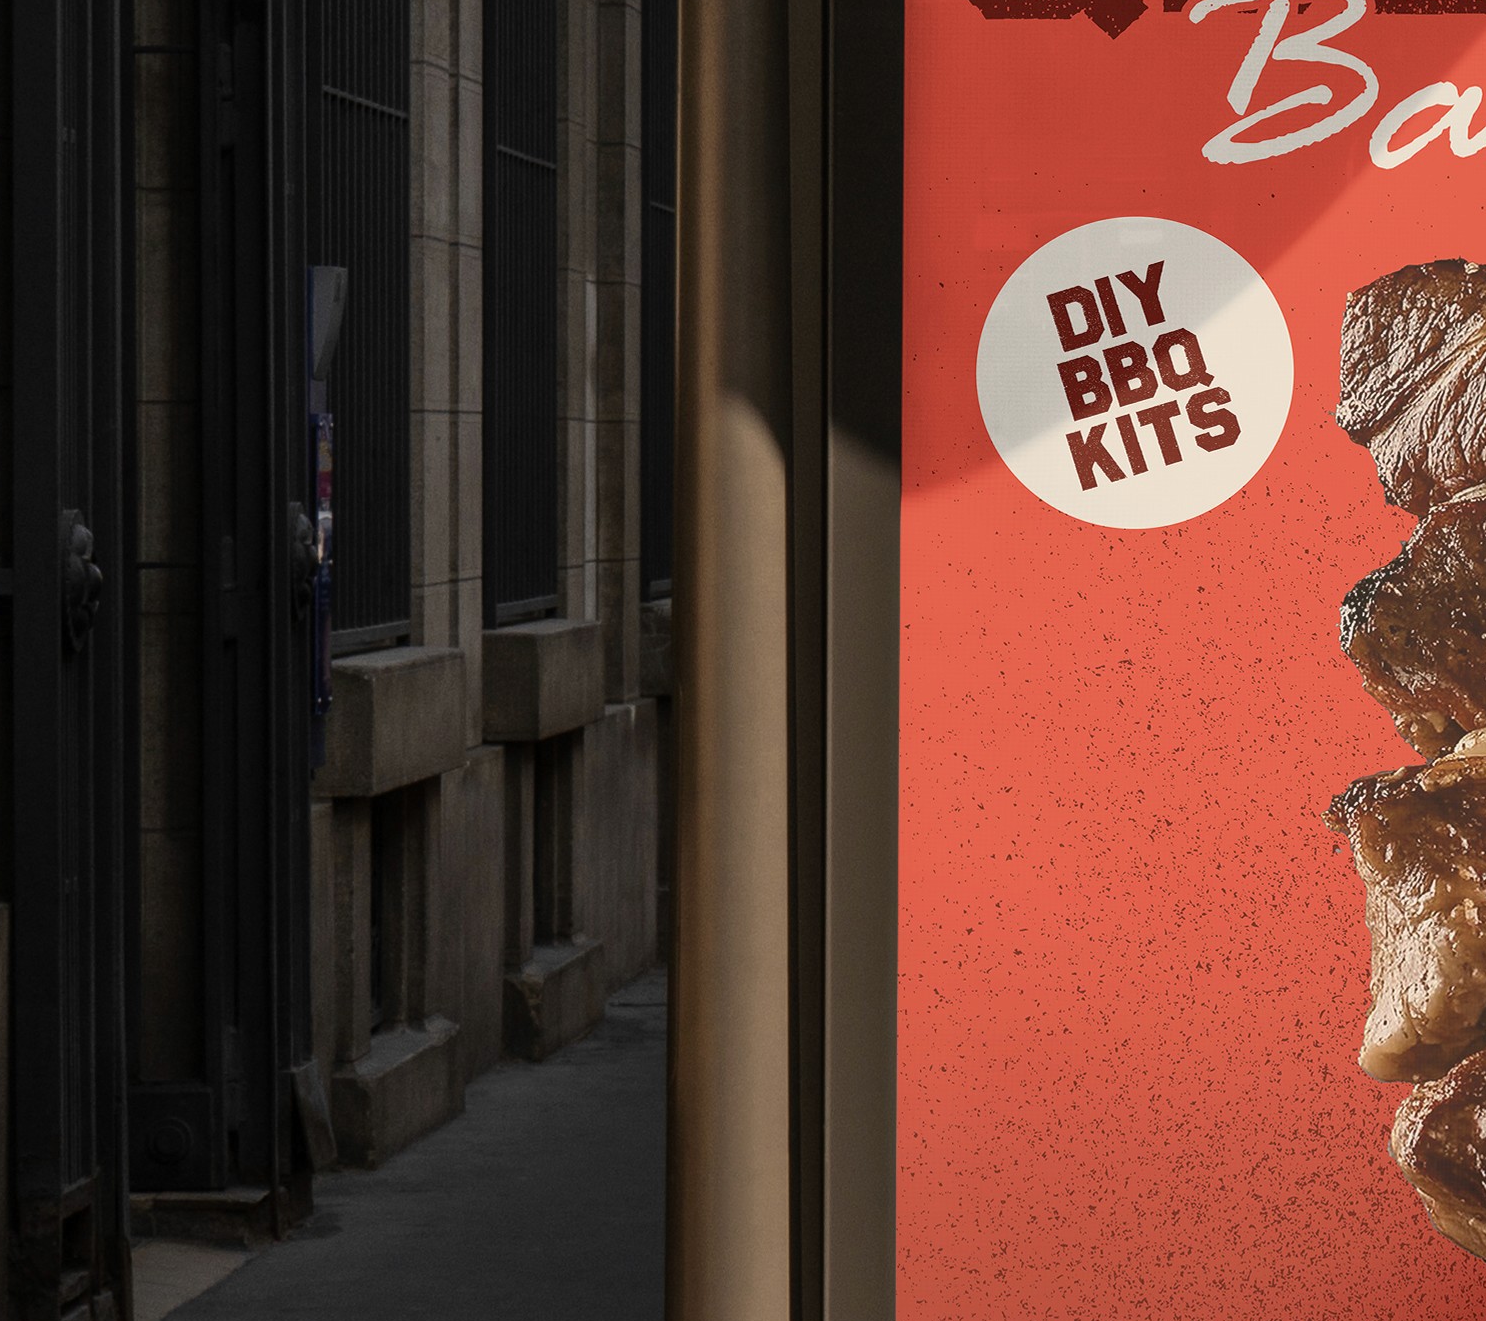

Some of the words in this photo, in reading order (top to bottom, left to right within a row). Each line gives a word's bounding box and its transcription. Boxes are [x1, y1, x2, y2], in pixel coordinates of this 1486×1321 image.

[1046, 260, 1166, 353] DIY
[1057, 328, 1215, 421] BBQ
[1065, 387, 1242, 491] KITS
